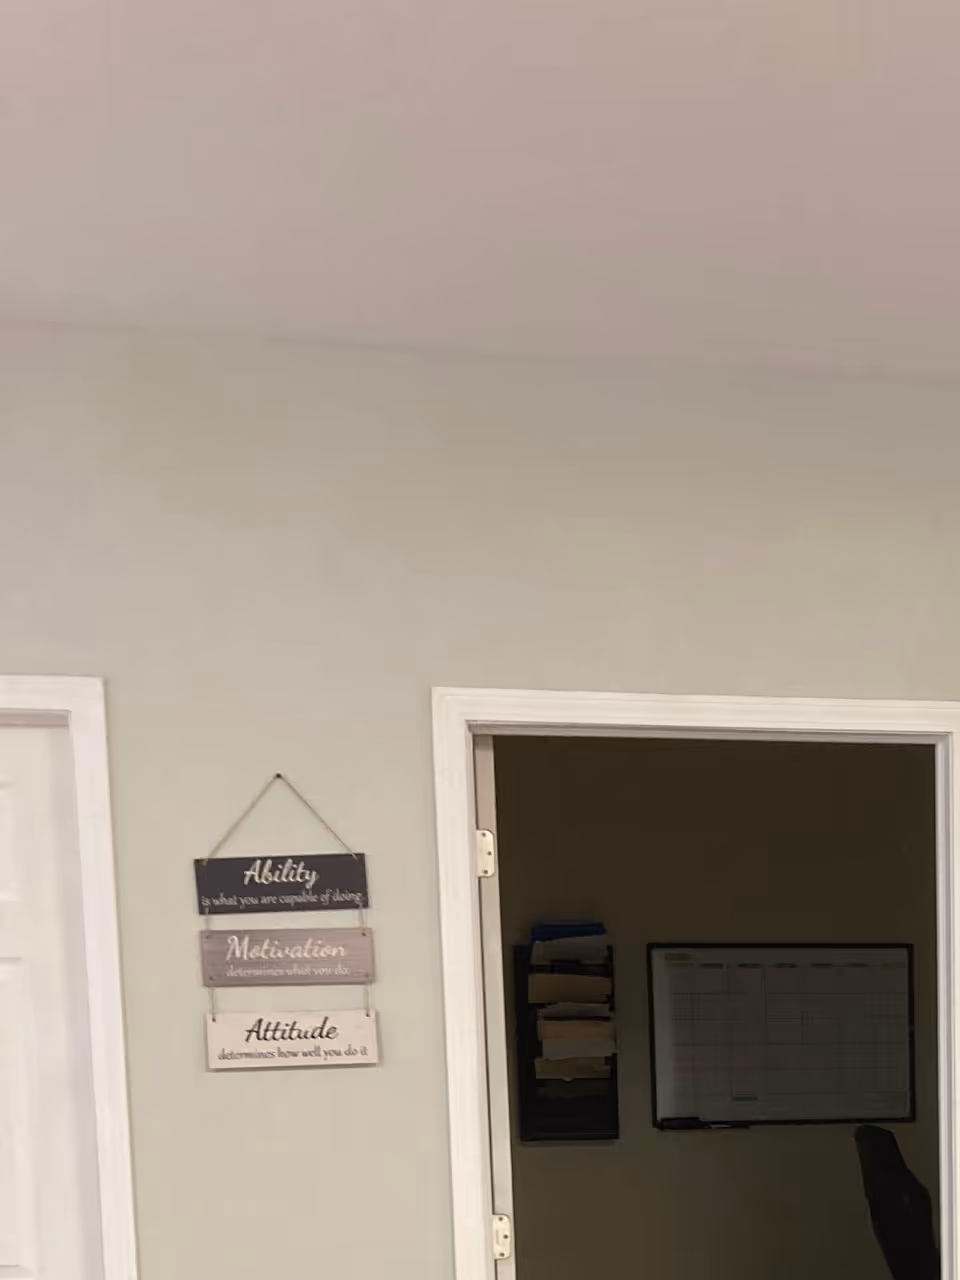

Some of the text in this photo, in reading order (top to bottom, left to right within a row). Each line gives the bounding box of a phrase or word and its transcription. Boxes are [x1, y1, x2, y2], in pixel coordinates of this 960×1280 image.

[243, 858, 318, 889] Ability
[212, 891, 238, 907] what
[239, 895, 260, 910] you
[260, 895, 278, 905] are
[279, 890, 318, 908] capable
[319, 888, 333, 906] of
[225, 934, 346, 961] Motivation
[285, 962, 312, 977] what
[312, 966, 333, 978] you
[244, 1015, 338, 1043] Attitude
[217, 1043, 369, 1062] determines how well you do it
